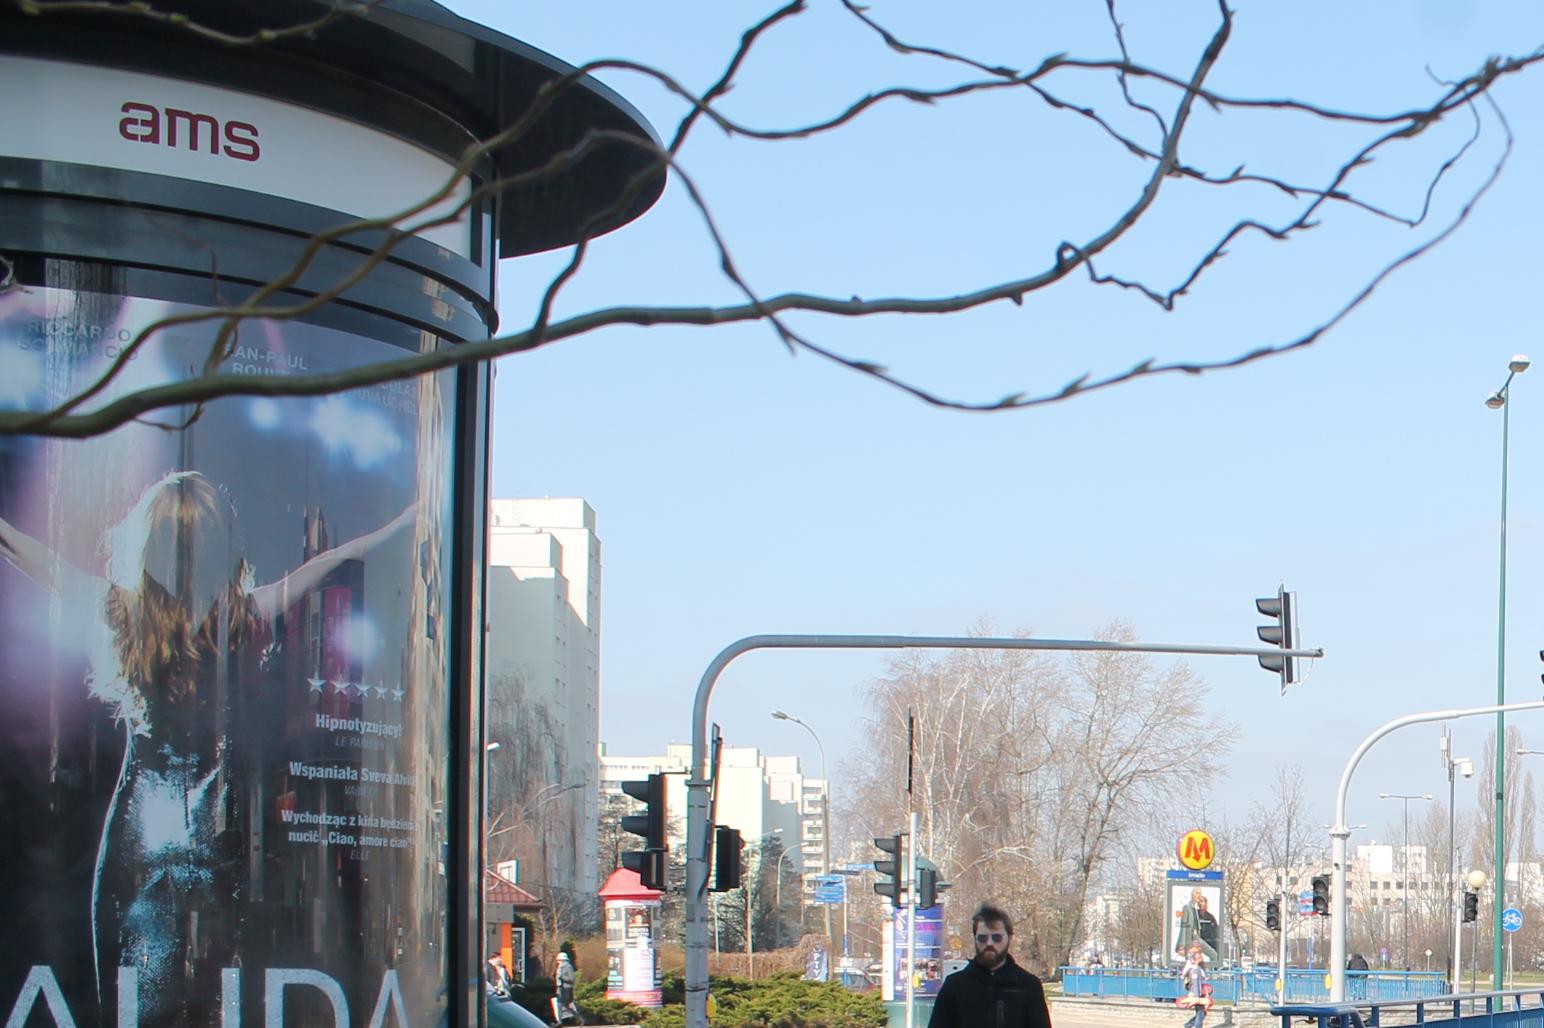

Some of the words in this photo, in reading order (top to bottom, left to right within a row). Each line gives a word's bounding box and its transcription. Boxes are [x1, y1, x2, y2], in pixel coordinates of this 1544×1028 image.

[119, 102, 260, 162] ams
[289, 761, 358, 781] Wspaniała
[361, 767, 392, 783] Sveva
[281, 809, 347, 829] Wychodząc
[350, 816, 356, 826] z
[288, 831, 319, 843] nucić
